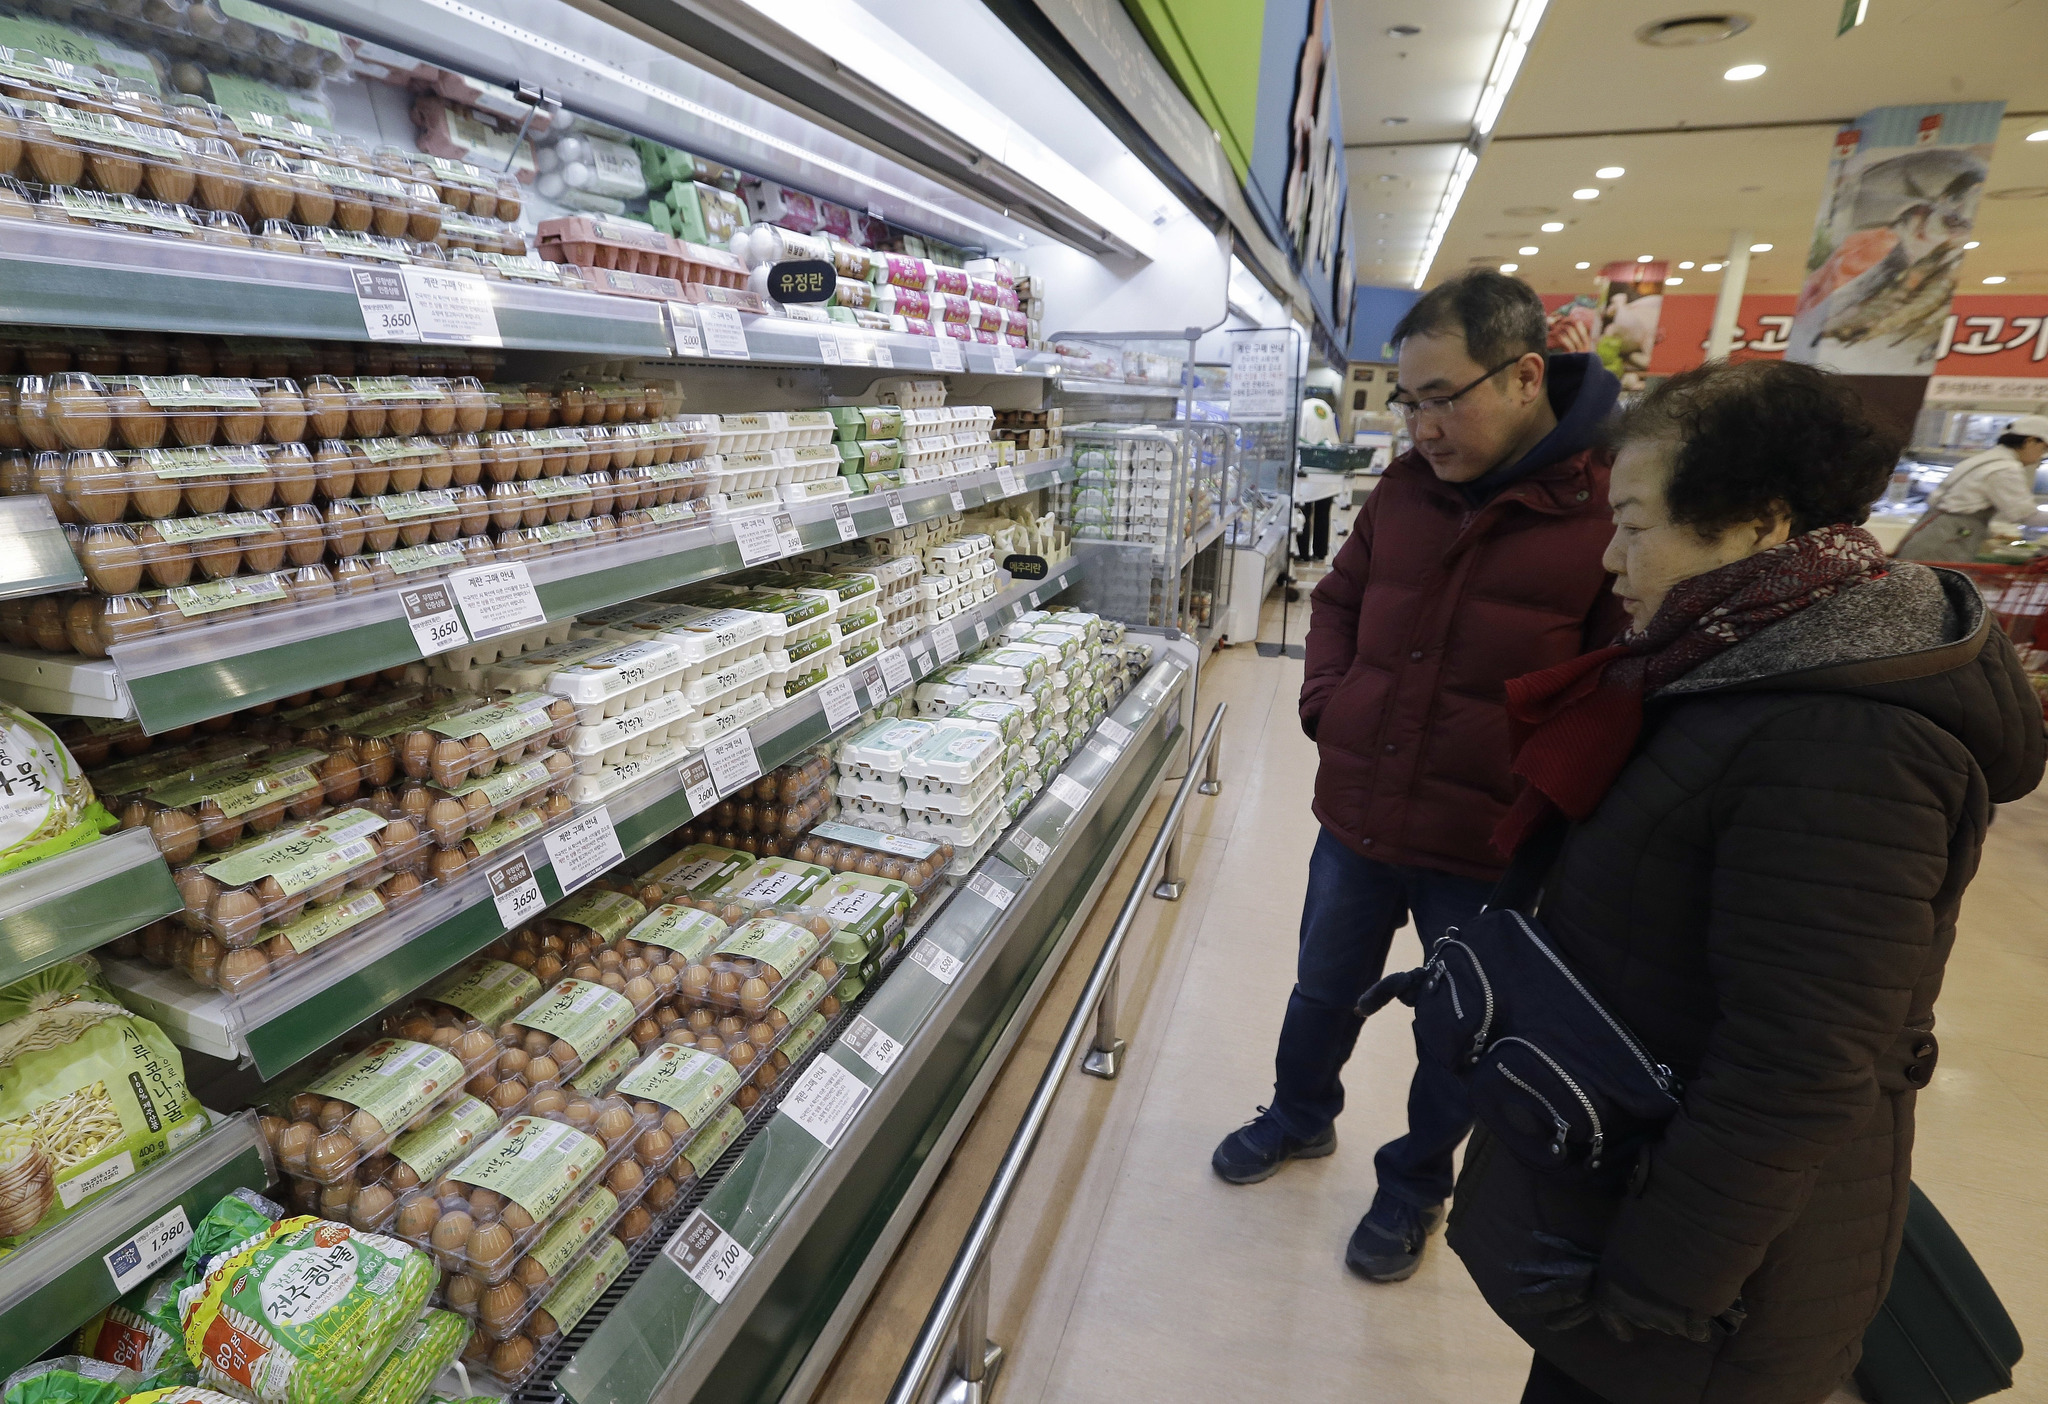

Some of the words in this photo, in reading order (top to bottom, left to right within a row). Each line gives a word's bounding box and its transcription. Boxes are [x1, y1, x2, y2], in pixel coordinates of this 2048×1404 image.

[423, 276, 439, 289] 계란
[780, 272, 824, 293] 유정란
[382, 314, 411, 329] 3,650
[683, 335, 699, 347] 5,000
[1009, 561, 1041, 574] 메추리란
[468, 576, 483, 588] 계란
[485, 572, 500, 584] 구매
[500, 569, 516, 582] 안내
[430, 620, 458, 641] 3,650
[716, 632, 737, 648] 햇달걀
[619, 666, 645, 685] 햇달걀
[717, 672, 738, 688] 햇달걀
[616, 715, 644, 734] 햇달걀
[716, 716, 737, 730] 햇달걀
[613, 761, 641, 780] 햇달걀
[558, 831, 571, 843] 계란
[573, 823, 585, 836] 구매
[585, 816, 598, 829] 안내
[513, 888, 537, 911] 3,650
[939, 956, 954, 972] 6,500
[876, 1039, 894, 1061] 5,100
[123, 1026, 185, 1123] 시루콩나물
[132, 1075, 147, 1100] 100%
[795, 1090, 808, 1103] 계란
[804, 1080, 817, 1093] 구매
[813, 1067, 828, 1081] 안내
[138, 1143, 155, 1158] 400
[157, 1140, 164, 1150] g
[151, 1221, 184, 1253] 1,980
[688, 1221, 708, 1243] 무항생제
[694, 1228, 714, 1250] 인증상품
[362, 1261, 376, 1274] 400
[714, 1244, 740, 1280] 5,100
[267, 1245, 355, 1319] 전주콩나물
[304, 1297, 317, 1313] Korea
